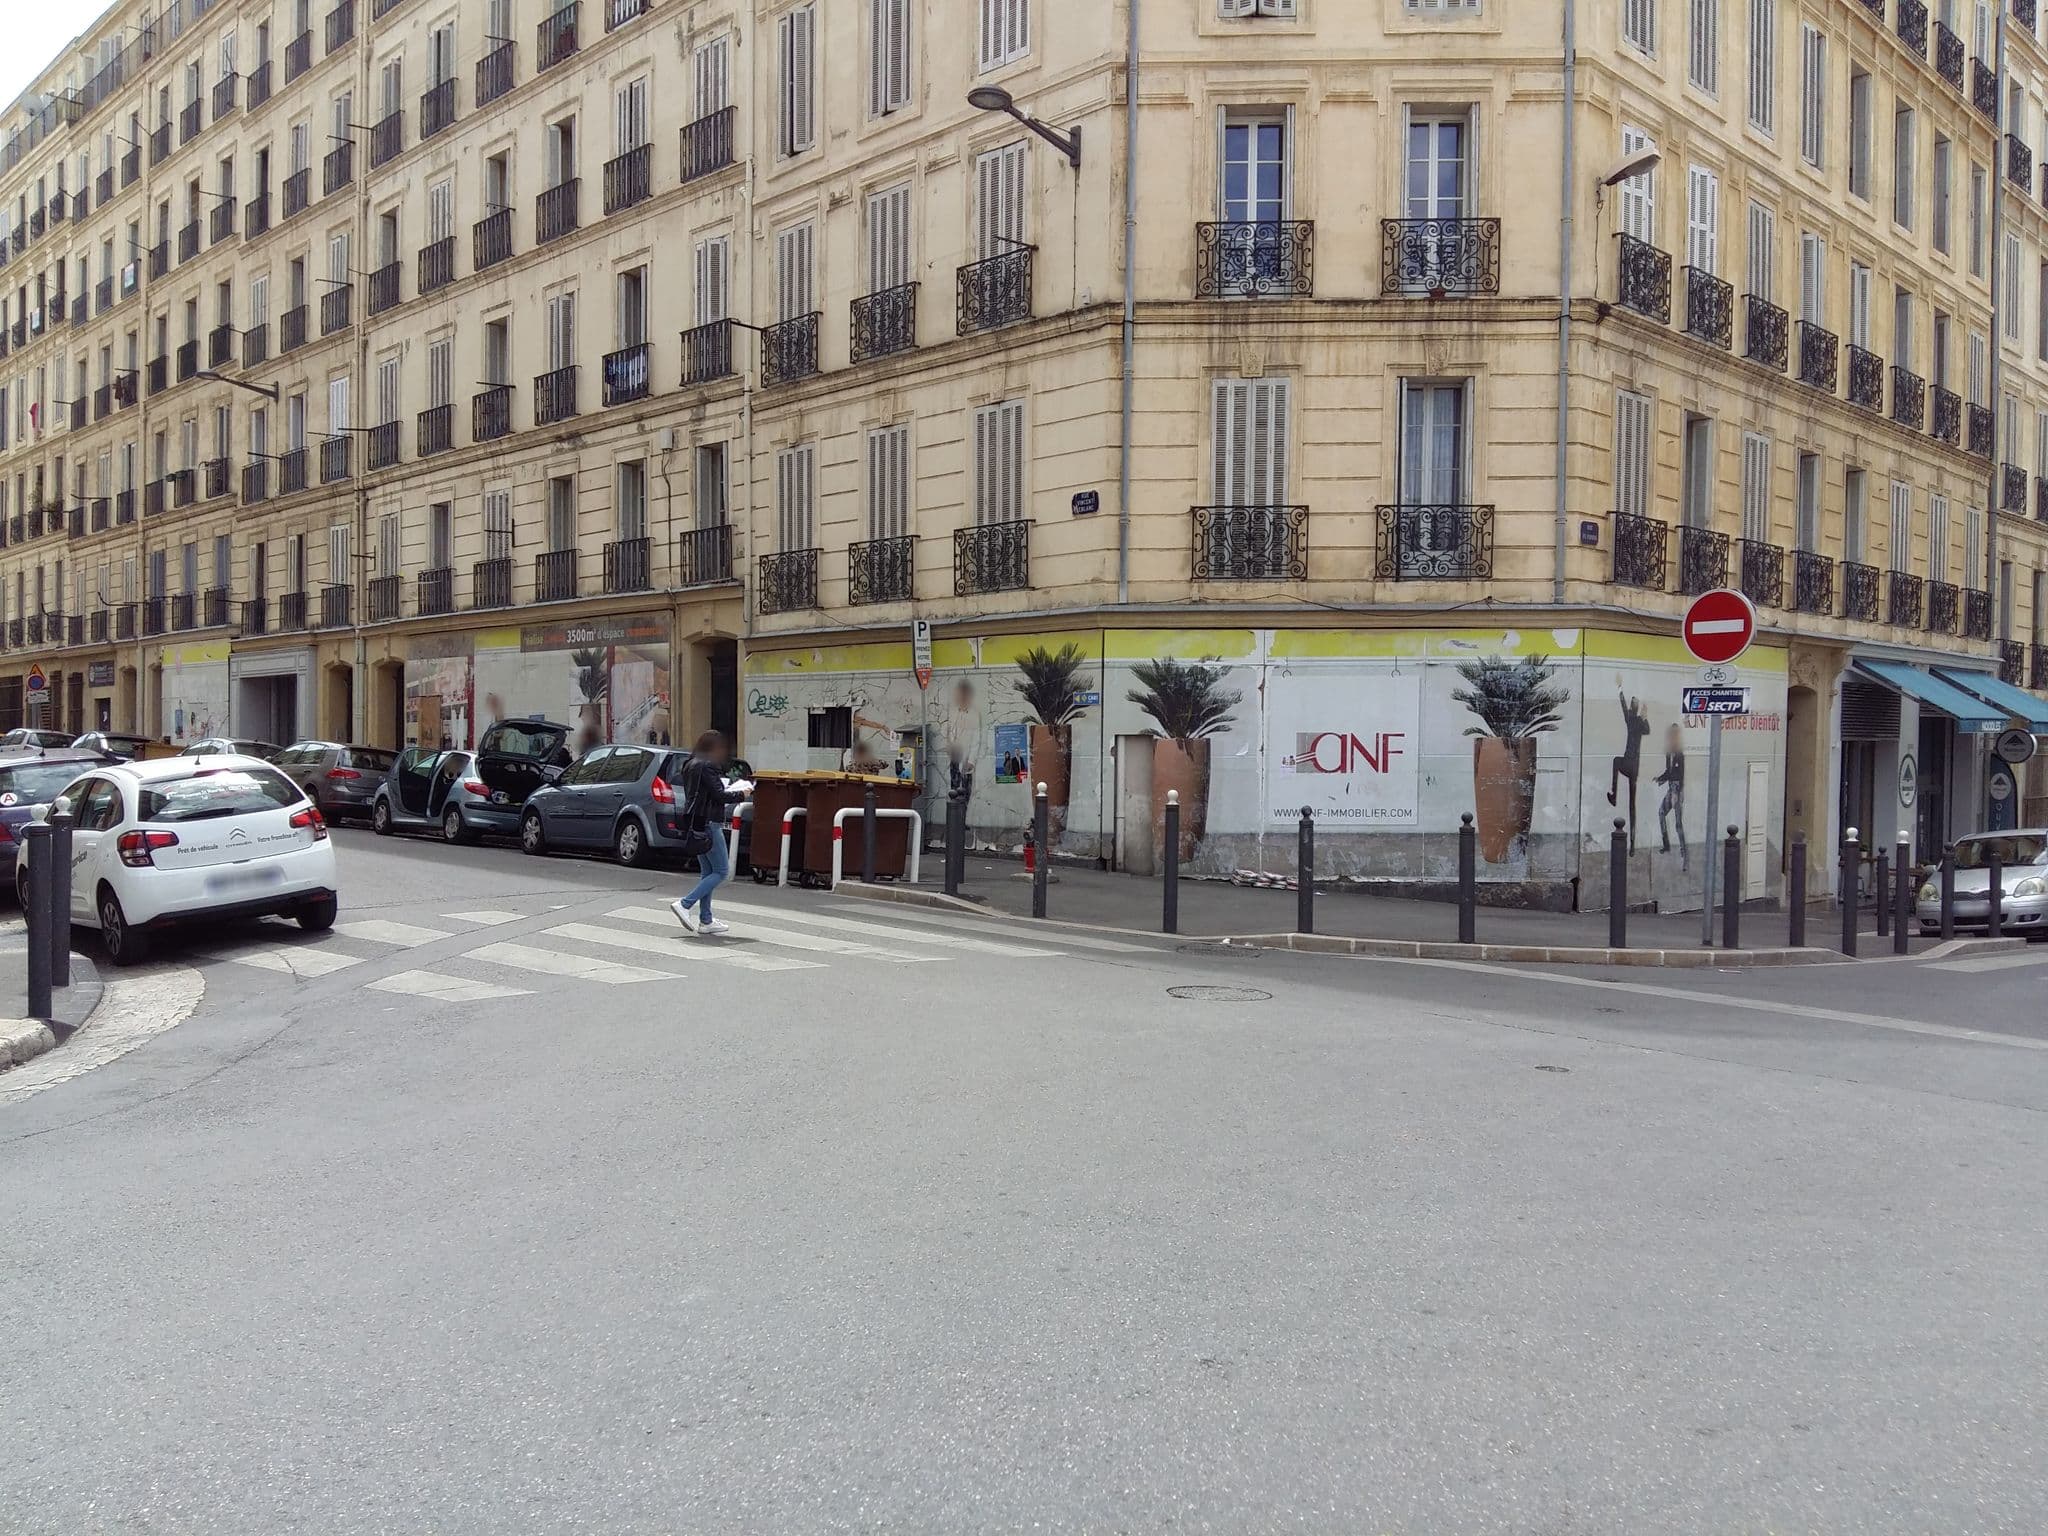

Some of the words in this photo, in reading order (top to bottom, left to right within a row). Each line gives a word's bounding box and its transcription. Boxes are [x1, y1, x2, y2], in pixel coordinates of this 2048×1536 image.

[918, 621, 927, 637] P
[1707, 702, 1741, 711] SECTP
[4, 793, 15, 803] A
